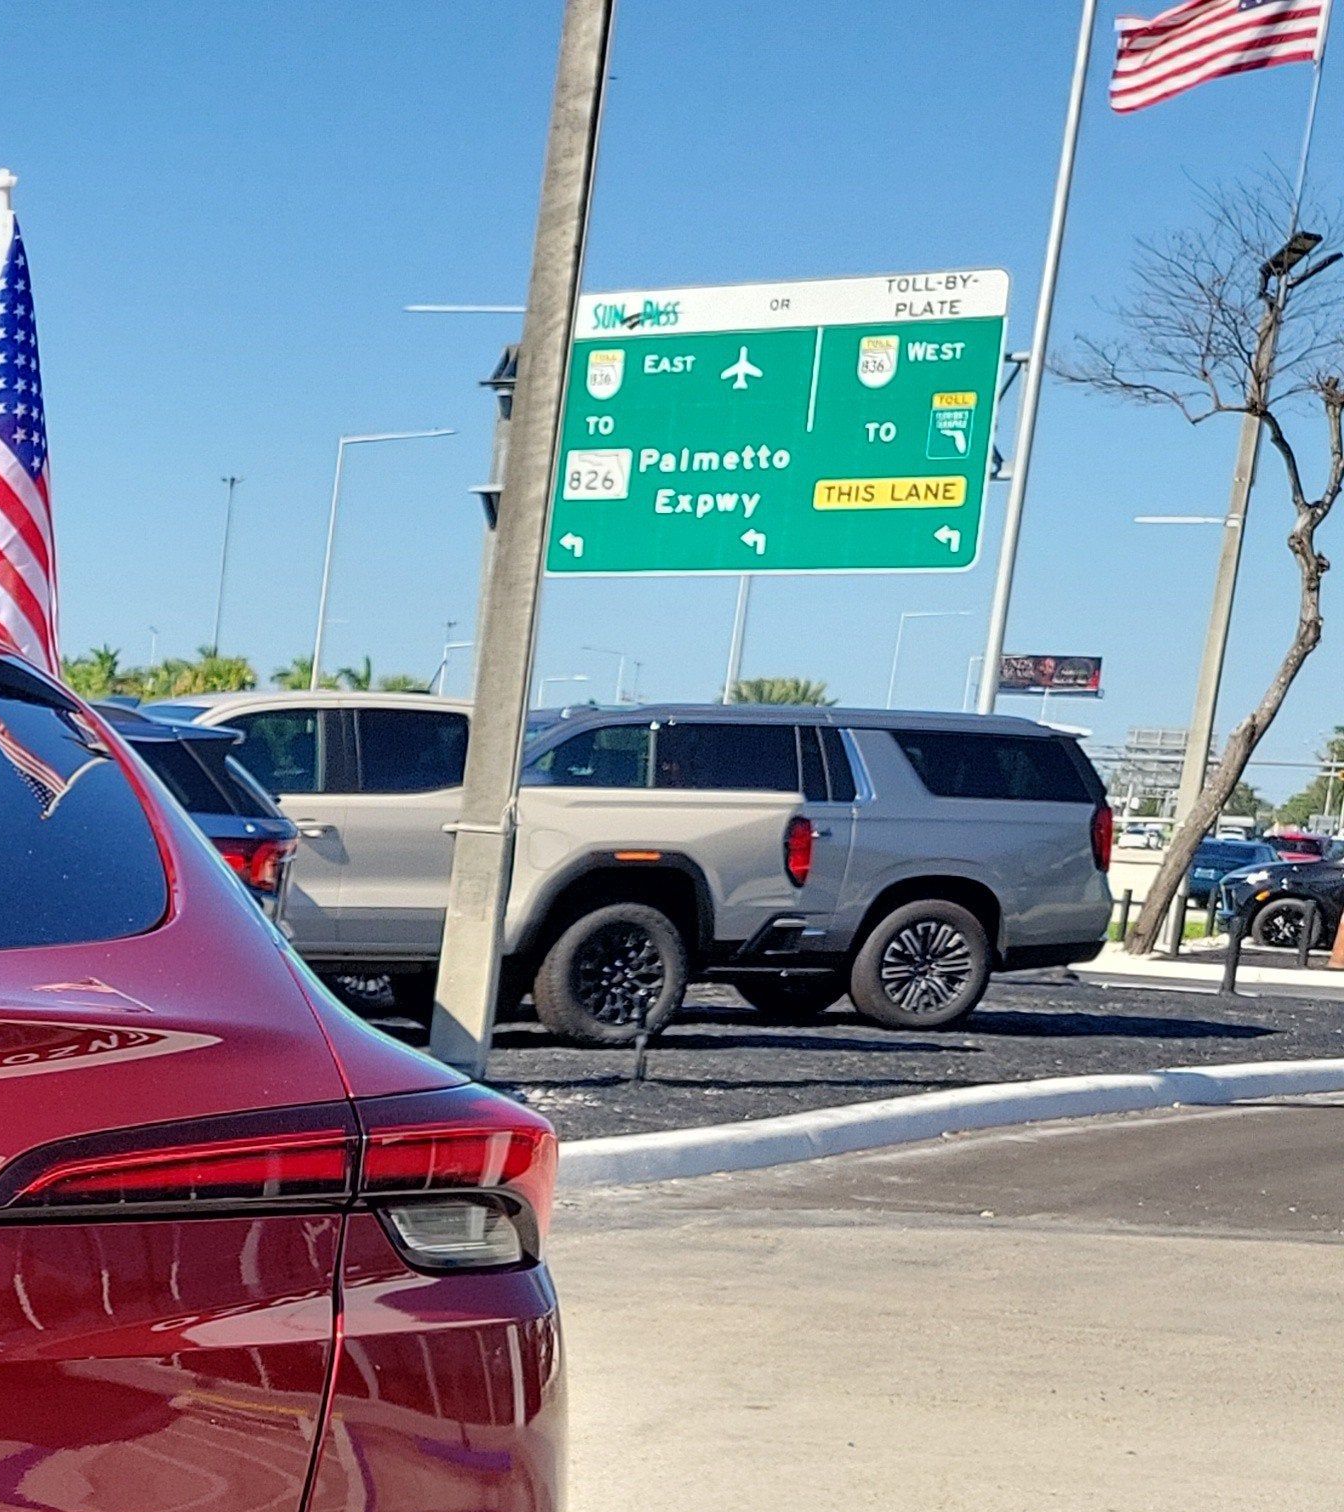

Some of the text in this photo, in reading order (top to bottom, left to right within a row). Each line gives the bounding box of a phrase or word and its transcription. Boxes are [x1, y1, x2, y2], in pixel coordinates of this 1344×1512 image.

[887, 274, 979, 294] TOLL-BY-
[770, 298, 790, 311] OR
[895, 300, 961, 317] PLATE
[907, 341, 965, 362] WEST
[644, 354, 696, 374] EAST
[586, 416, 614, 435] TO
[865, 422, 896, 442] TO
[639, 444, 790, 473] Palmetto
[569, 470, 614, 491] 826
[655, 488, 761, 518] Expwy
[825, 483, 957, 503] THIS LANE
